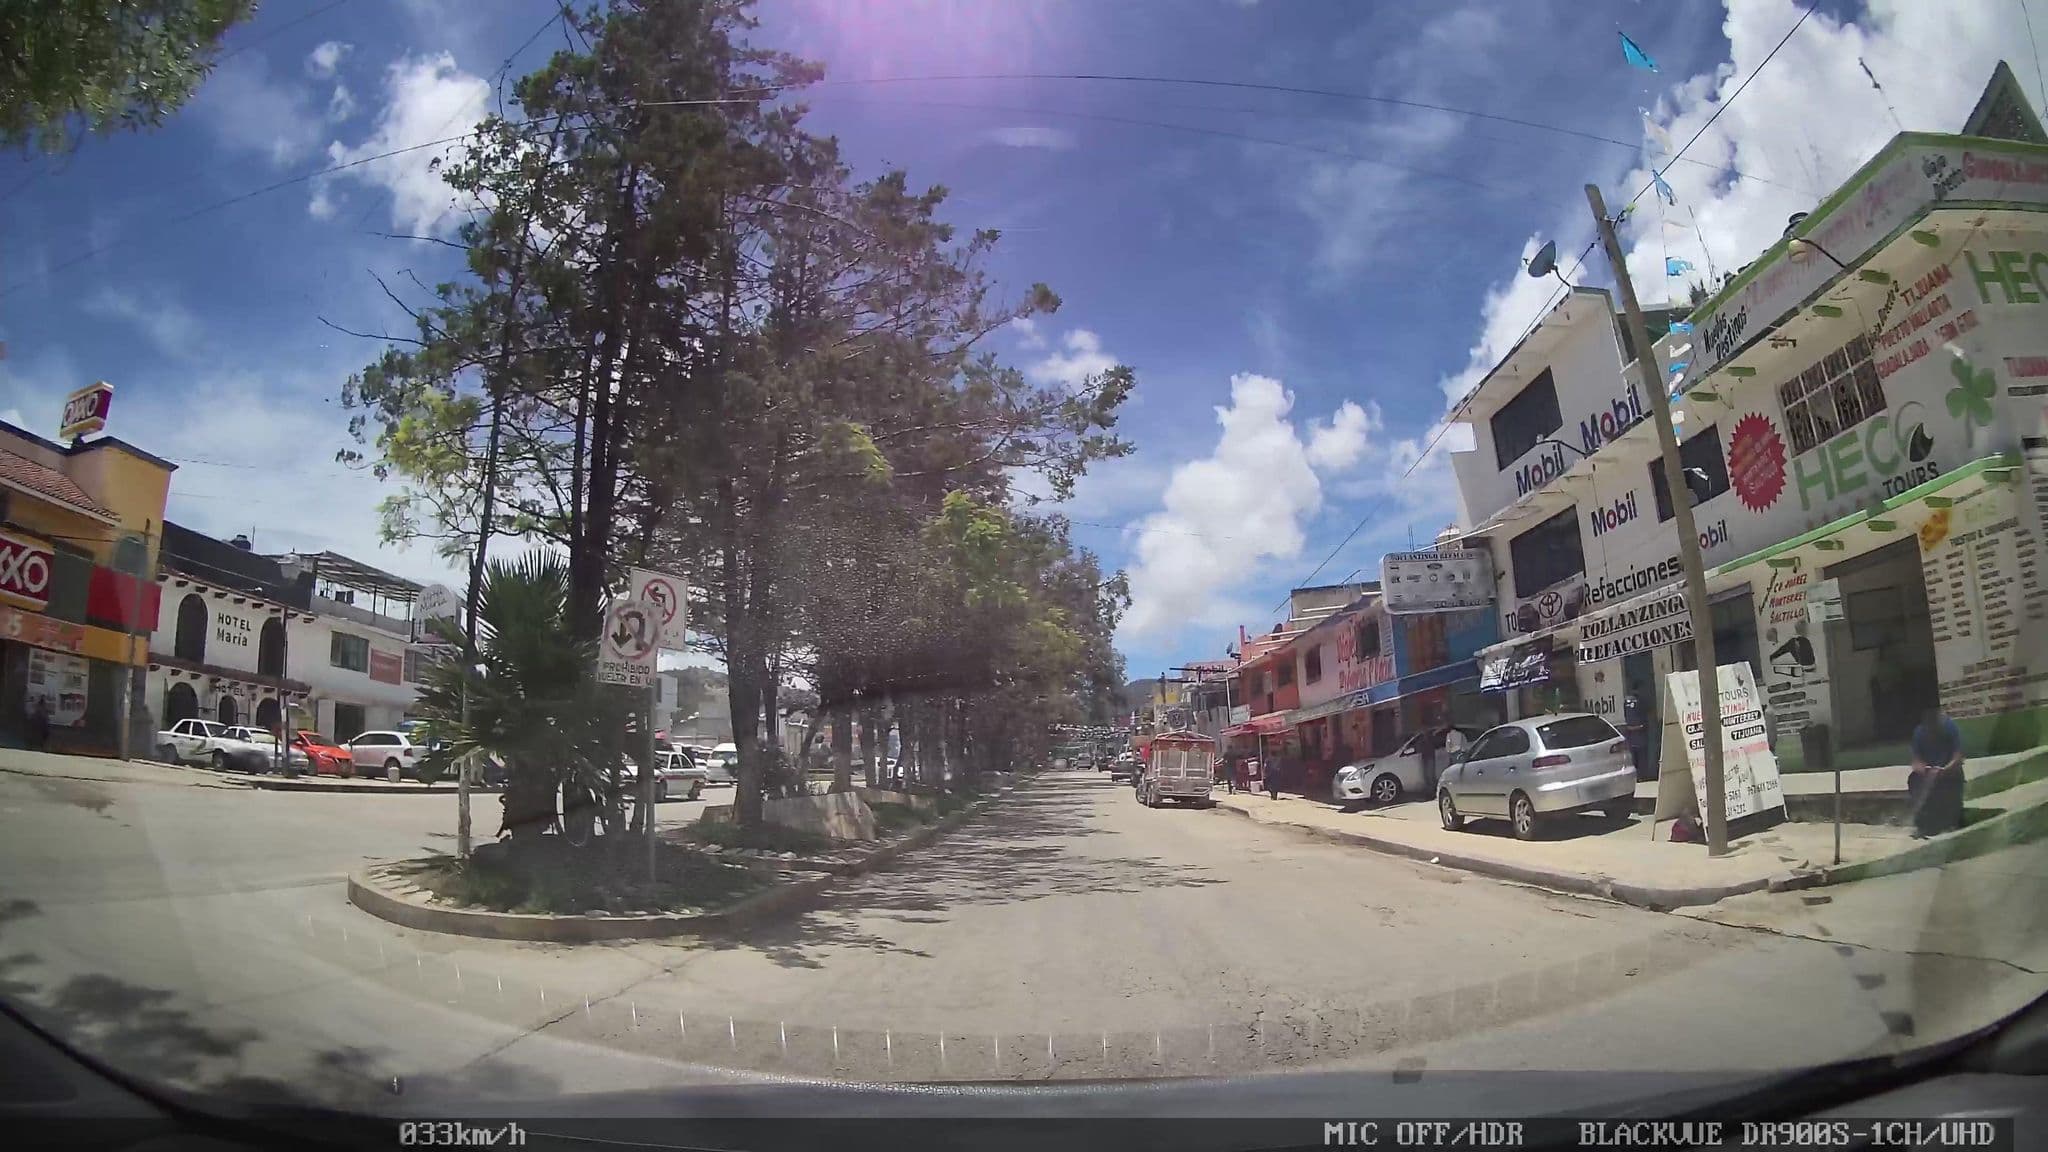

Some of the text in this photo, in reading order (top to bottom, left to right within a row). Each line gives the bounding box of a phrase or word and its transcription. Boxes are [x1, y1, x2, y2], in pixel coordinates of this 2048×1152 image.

[1900, 264, 1952, 306] TIJUANA
[1716, 304, 1747, 361] Destinos
[64, 393, 98, 427] OXXO
[1581, 382, 1642, 450] Mobil
[1515, 442, 1565, 498] Mobil
[1882, 461, 1941, 497] TOURS
[1591, 490, 1638, 538] Mobil
[1699, 519, 1728, 551] obil
[1584, 555, 1682, 607] Refacciones
[217, 612, 252, 632] HOTEL
[603, 661, 650, 675] PROHIBIDO
[630, 674, 641, 685] EN
[1584, 695, 1616, 717] Mobil
